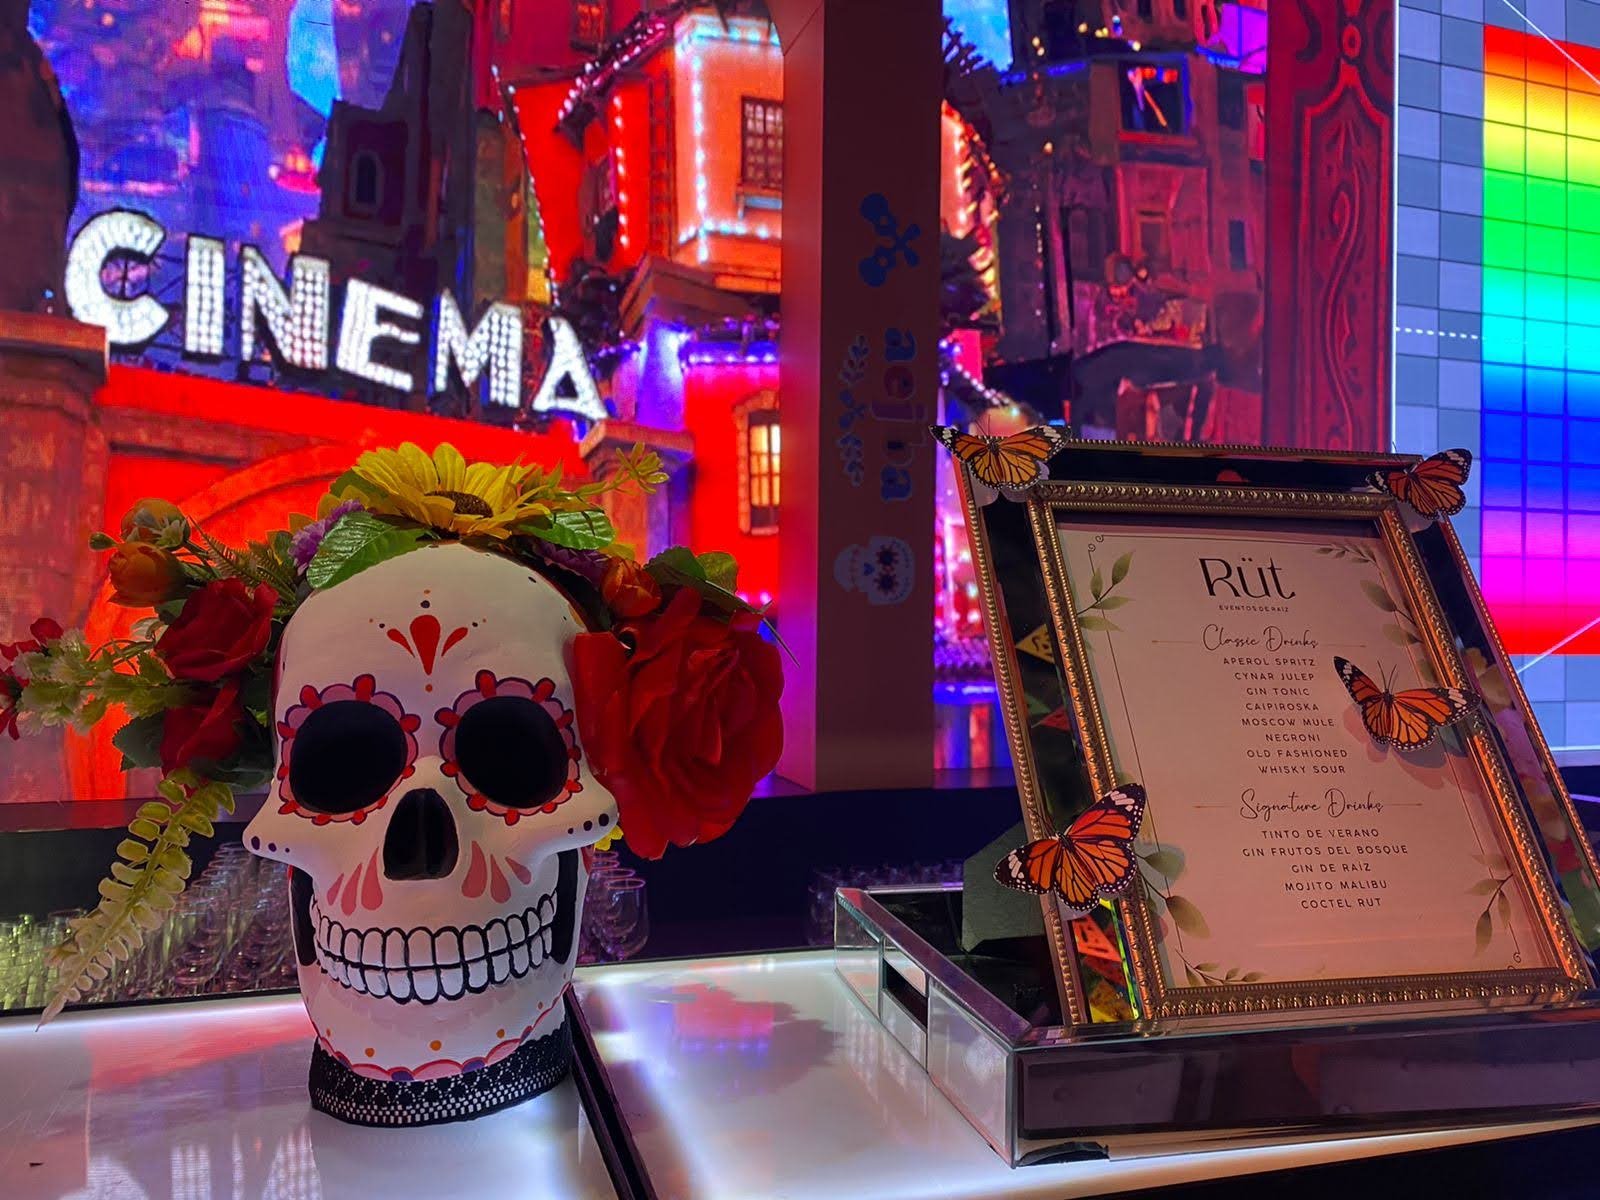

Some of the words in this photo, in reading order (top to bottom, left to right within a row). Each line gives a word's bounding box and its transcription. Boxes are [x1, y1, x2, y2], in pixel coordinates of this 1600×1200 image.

[64, 208, 608, 420] CINEMA
[1199, 557, 1296, 599] Rüt
[1202, 623, 1260, 651] Classic
[1263, 625, 1319, 652] Drinks
[1223, 656, 1270, 667] APEROL
[1275, 657, 1316, 667] SPRITZ
[1234, 671, 1275, 681] CYNAR
[1280, 671, 1315, 682] JULEP
[1246, 687, 1268, 697] GIN
[1272, 687, 1310, 697] TONIC
[1245, 702, 1320, 712] CAIPIROSKA
[1241, 718, 1297, 728] MOSCOW
[1302, 718, 1335, 728] MULE
[1265, 733, 1321, 743] NEGRONI
[1246, 749, 1272, 759] OLD
[1277, 749, 1348, 759] FASHIONED
[1258, 765, 1307, 775] WHISKY
[1312, 764, 1346, 775] SOUR
[1240, 788, 1321, 822] Signature
[1324, 788, 1384, 818] Drinks
[1261, 830, 1301, 840] TINTO
[1306, 829, 1323, 839] DE
[1328, 828, 1380, 838] VERANO
[1242, 848, 1265, 858] GIN
[1270, 847, 1322, 857] FRUTOS
[1327, 846, 1352, 856] DEL
[1356, 844, 1409, 856] BOSQUE
[1291, 864, 1314, 874] GIN
[1319, 863, 1337, 873] DE
[1341, 861, 1372, 873] RAÍZ
[1284, 881, 1334, 892] MOJITO
[1339, 879, 1388, 890] MALIBU
[1300, 898, 1352, 910] COCTEL
[1357, 897, 1382, 908] RUT
